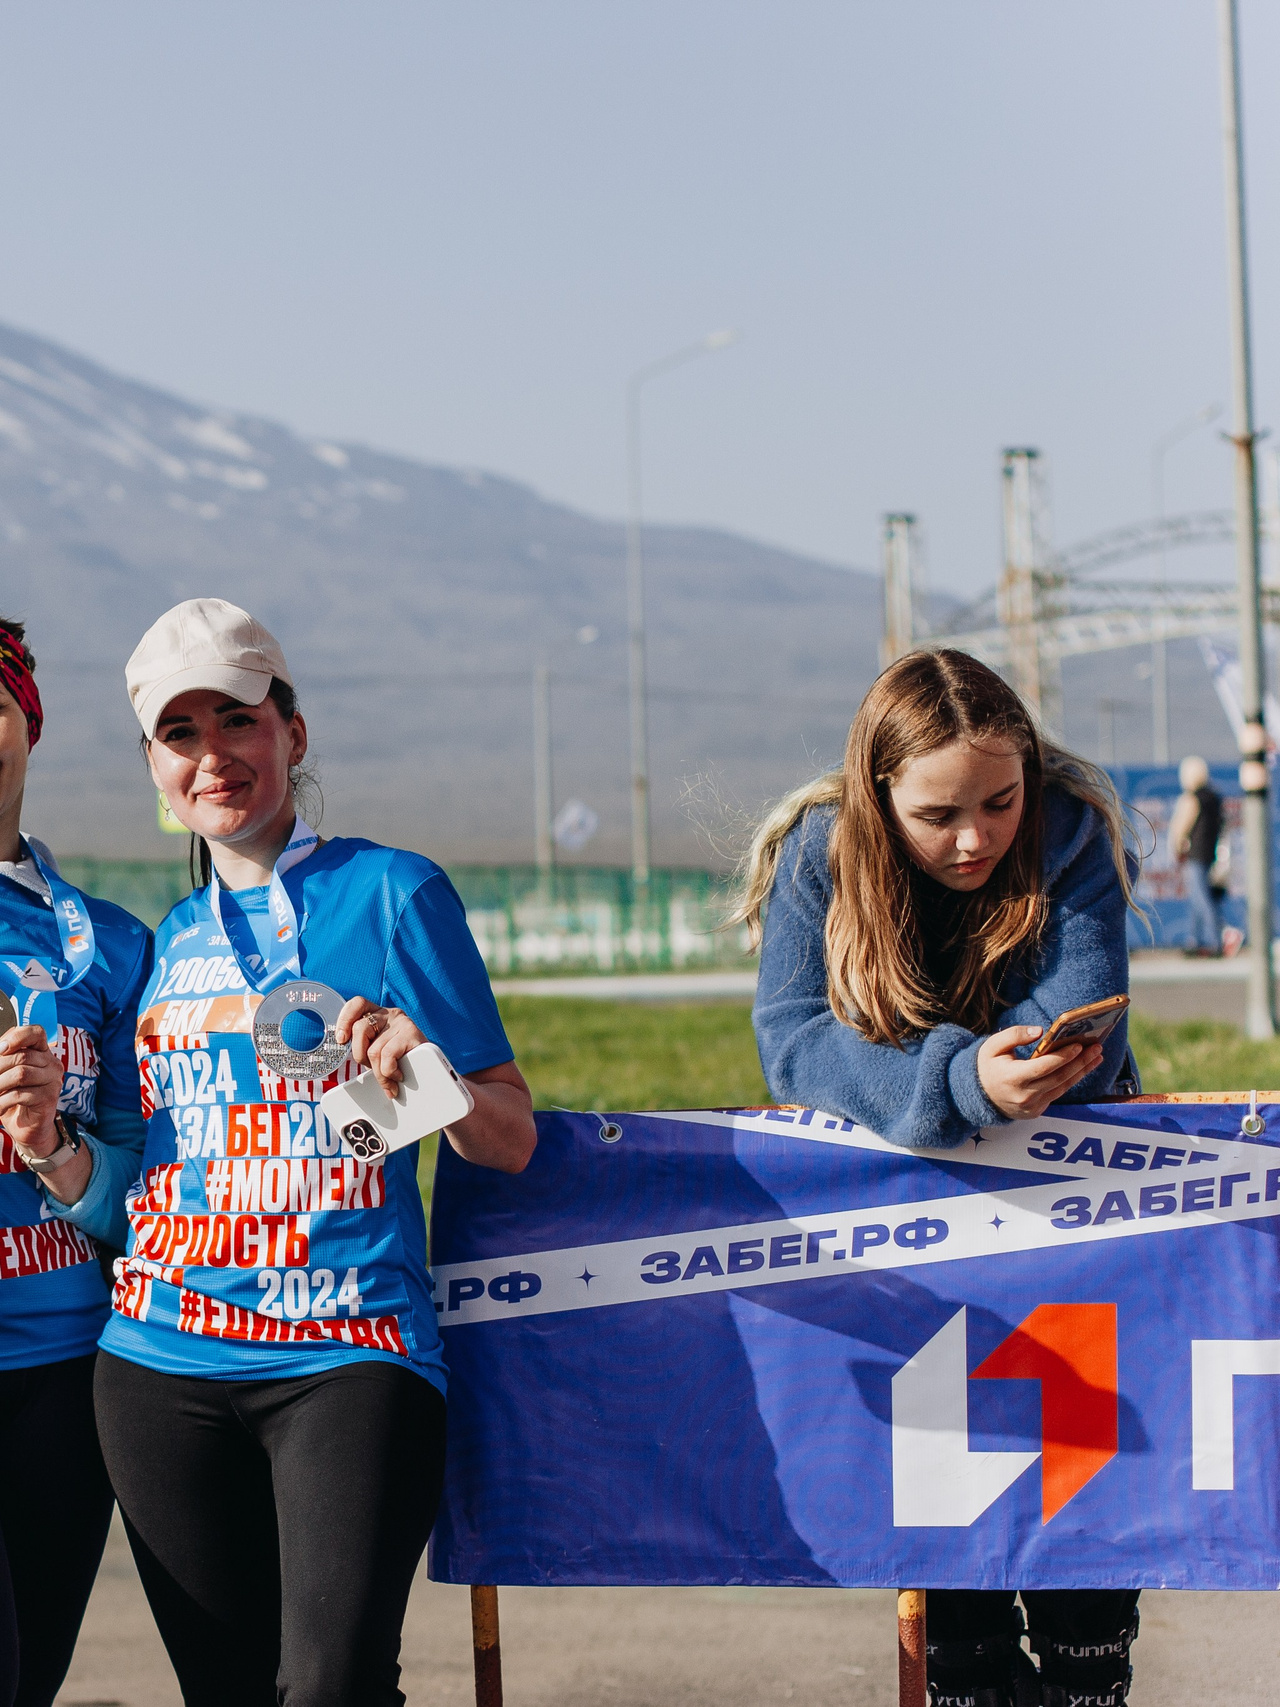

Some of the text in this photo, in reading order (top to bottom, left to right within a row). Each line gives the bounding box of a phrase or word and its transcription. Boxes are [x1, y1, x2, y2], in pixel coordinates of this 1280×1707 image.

[63, 900, 83, 931] ПСБ
[640, 1217, 950, 1285] ЗАБЕГ.РФ
[257, 1267, 363, 1319] 2024
